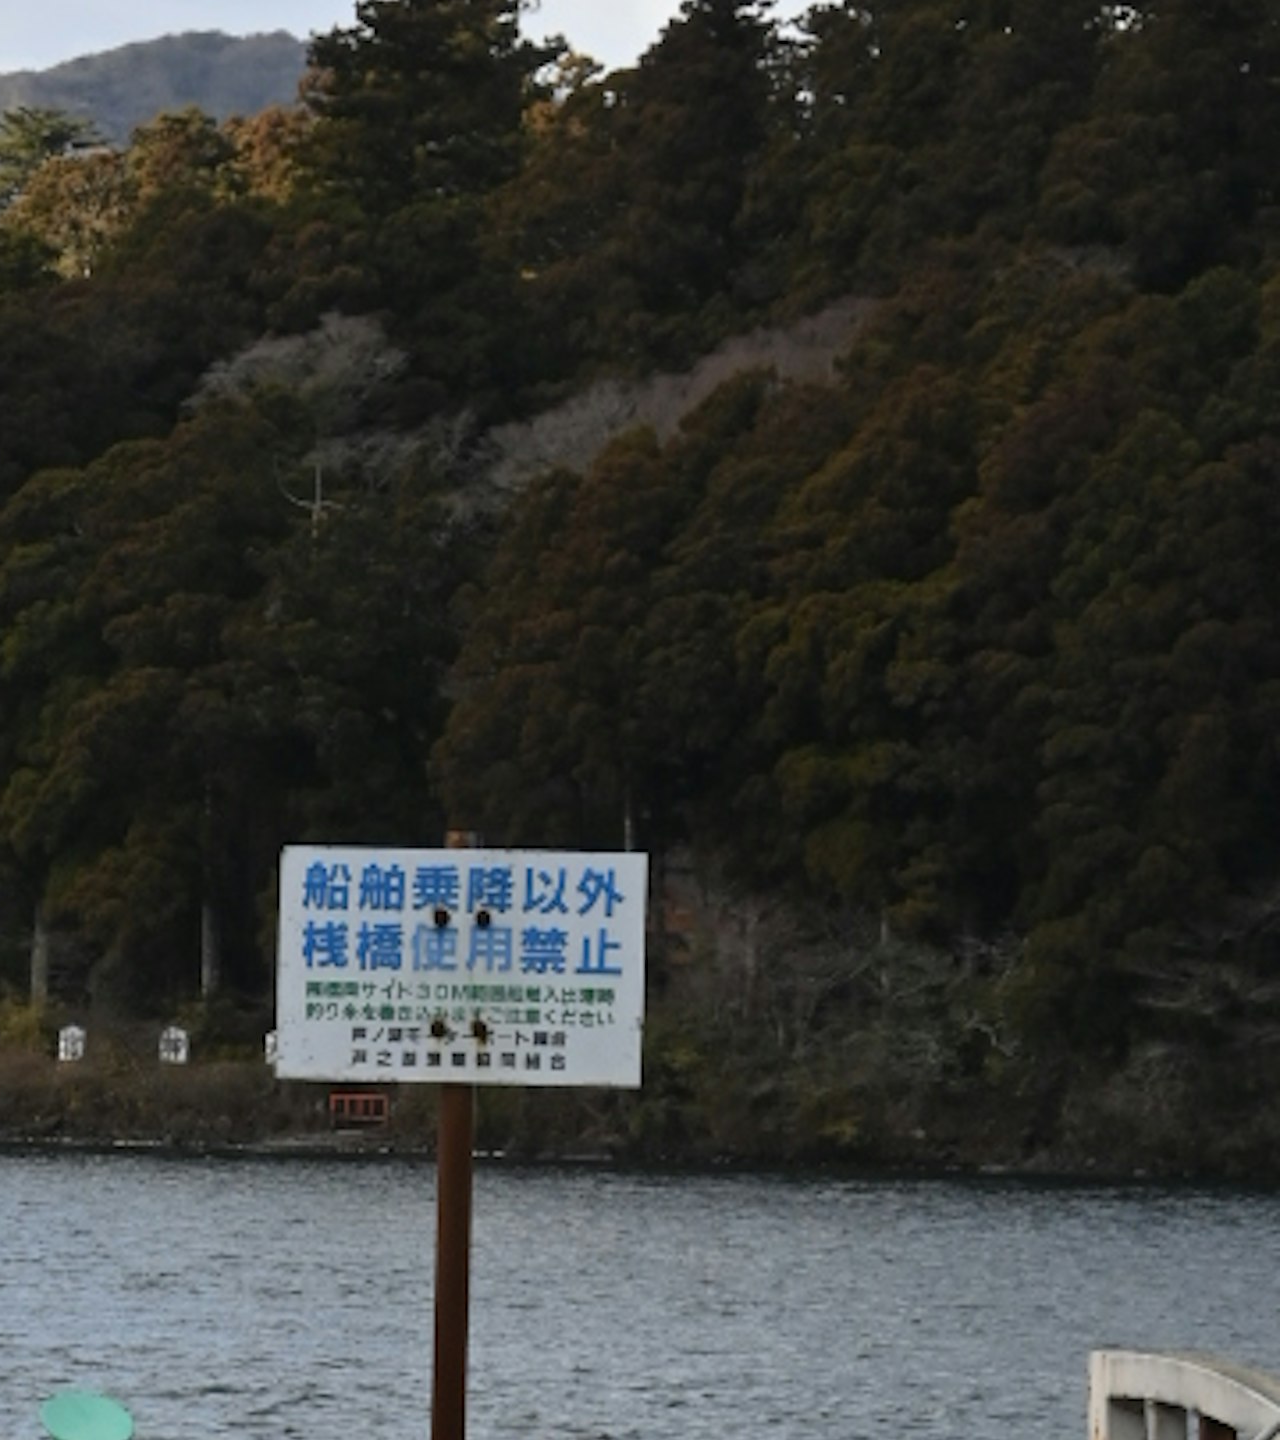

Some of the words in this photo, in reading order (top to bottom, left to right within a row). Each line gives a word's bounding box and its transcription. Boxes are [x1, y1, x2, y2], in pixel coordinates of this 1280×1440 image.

[302, 859, 624, 918] 船舶乗降以外
[302, 920, 622, 977] 桟橋使用禁止
